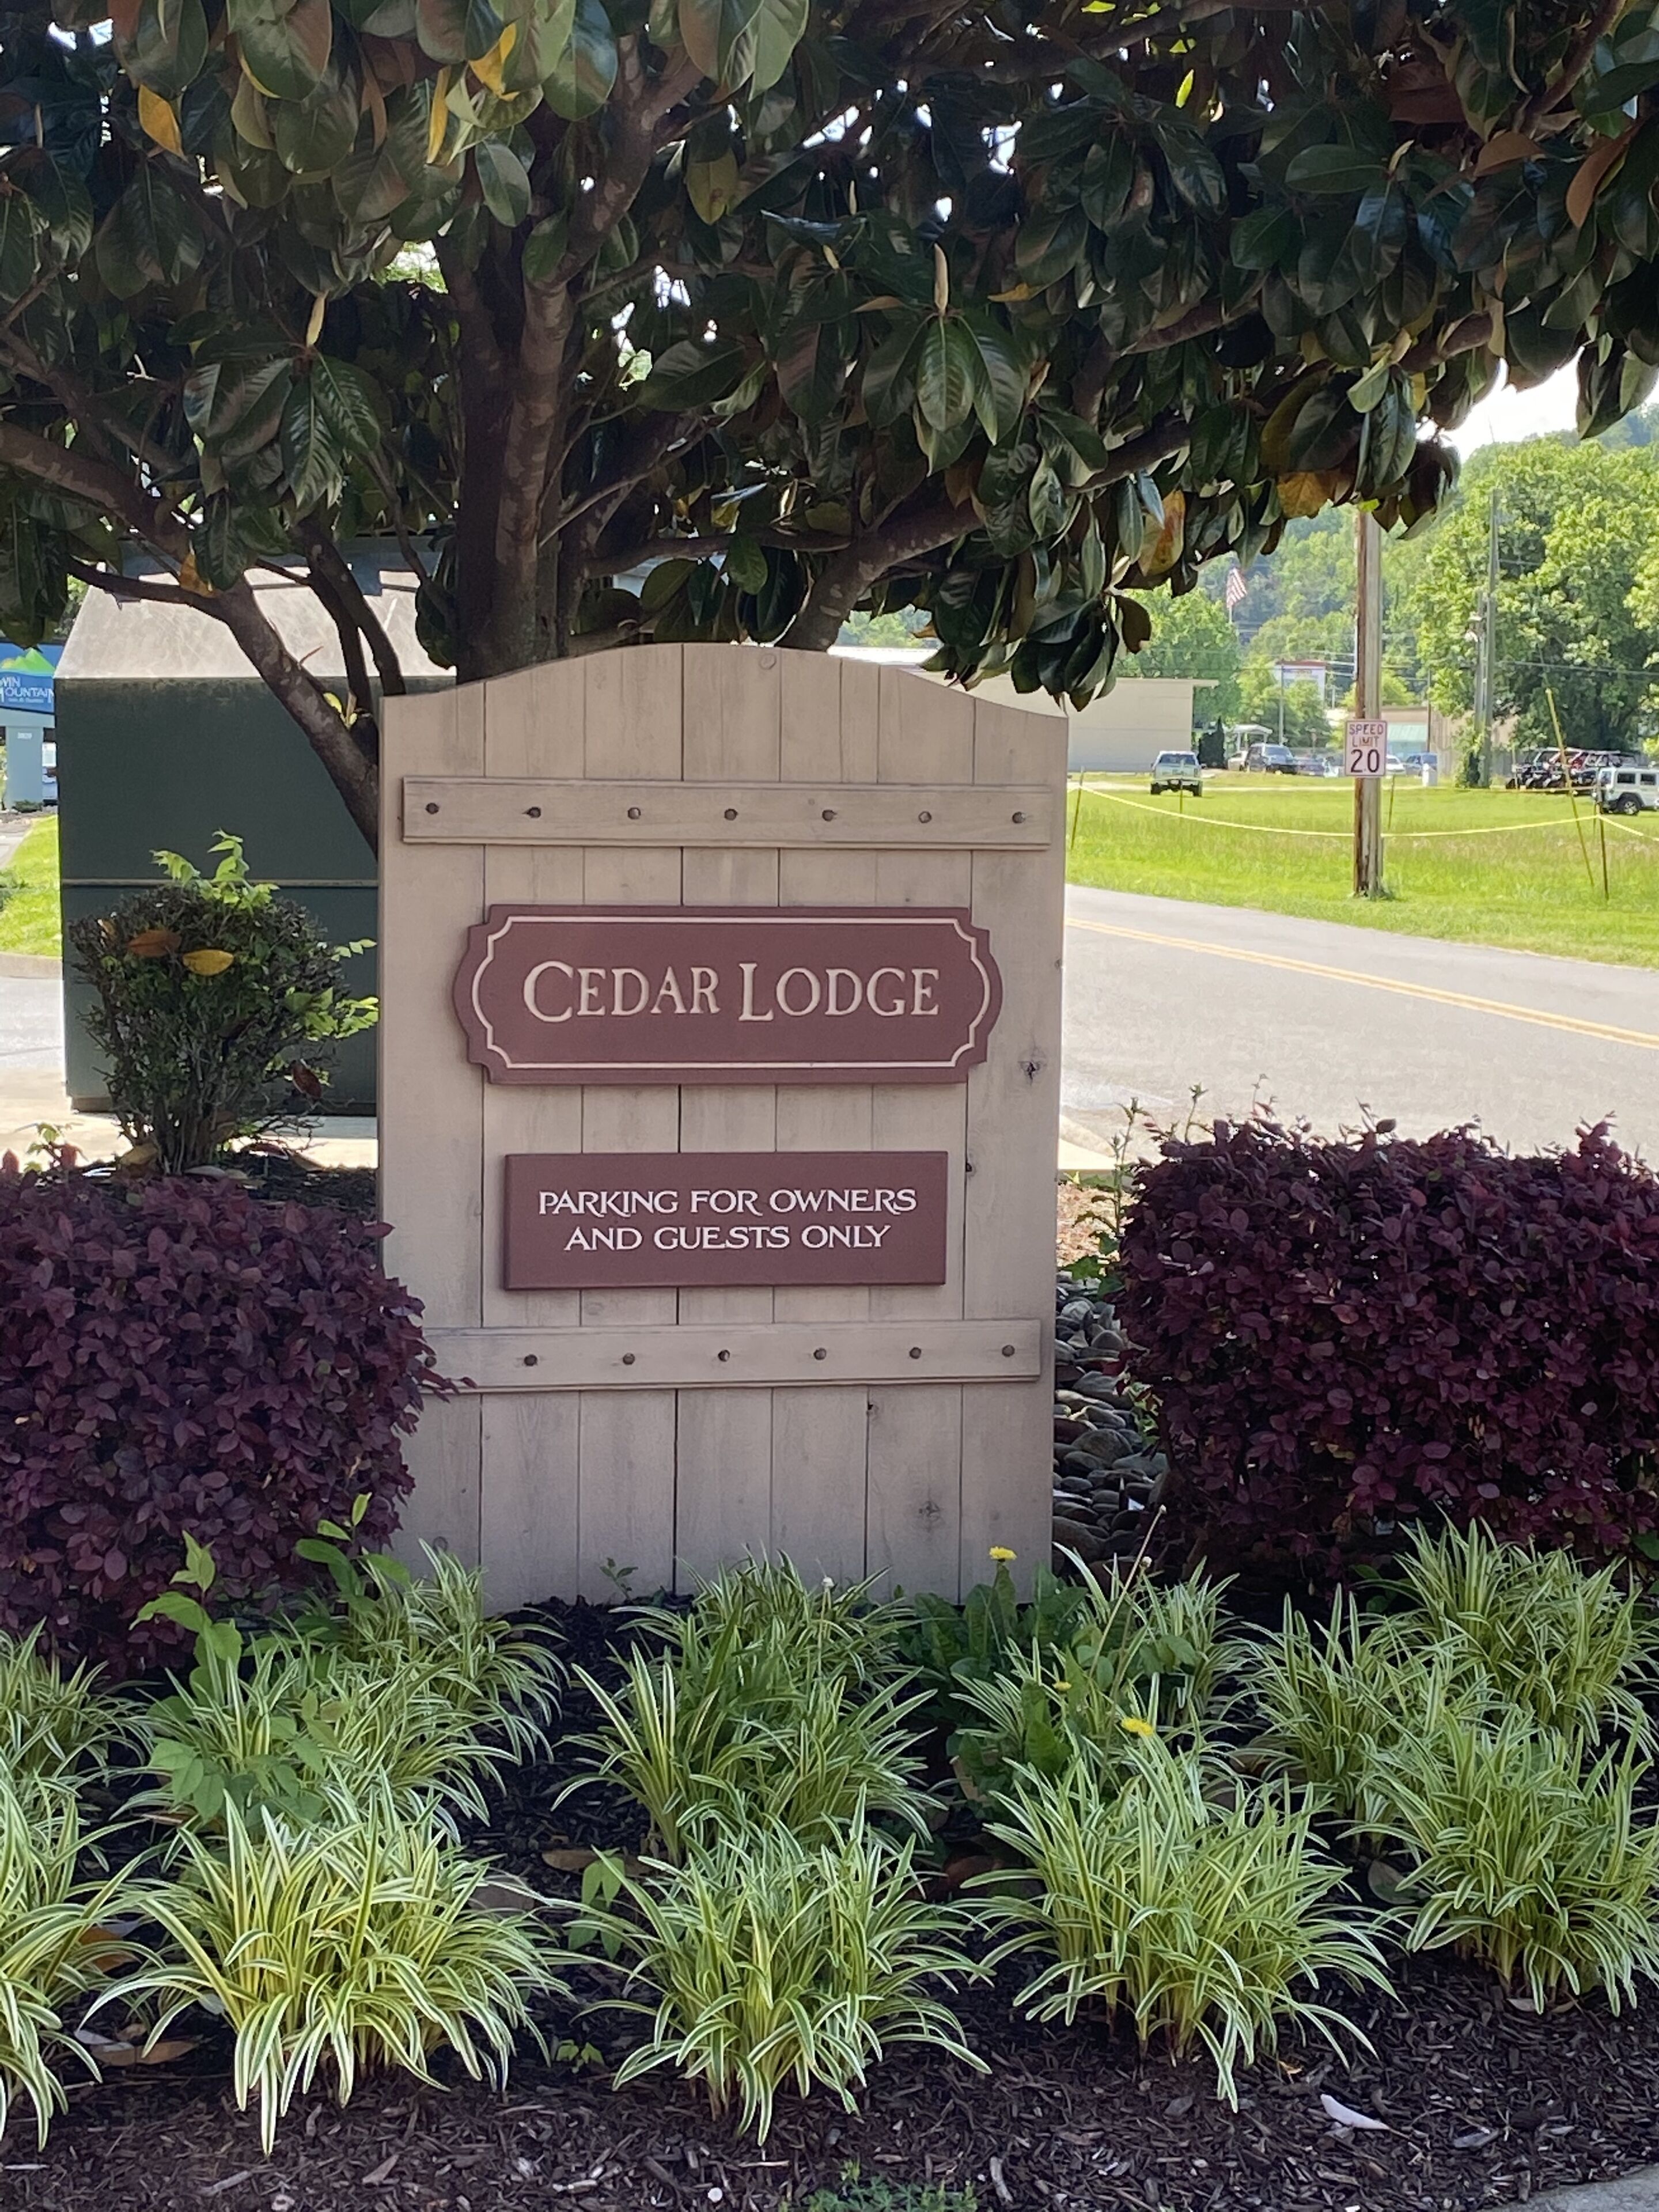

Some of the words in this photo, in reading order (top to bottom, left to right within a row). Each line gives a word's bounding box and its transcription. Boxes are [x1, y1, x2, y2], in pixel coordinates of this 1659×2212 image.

[0, 676, 21, 687] WIN
[1349, 724, 1384, 735] SPEED
[1352, 736, 1380, 748] LIMIT
[1351, 749, 1380, 773] 20
[523, 960, 721, 1023] CEDAR
[738, 963, 939, 1021] LODGE
[538, 1190, 679, 1218] PARKING
[691, 1190, 763, 1217] FOR
[770, 1188, 917, 1215] OWNERS
[564, 1226, 643, 1251] AND
[653, 1225, 790, 1251] GUESTS
[801, 1224, 892, 1249] ONLY
